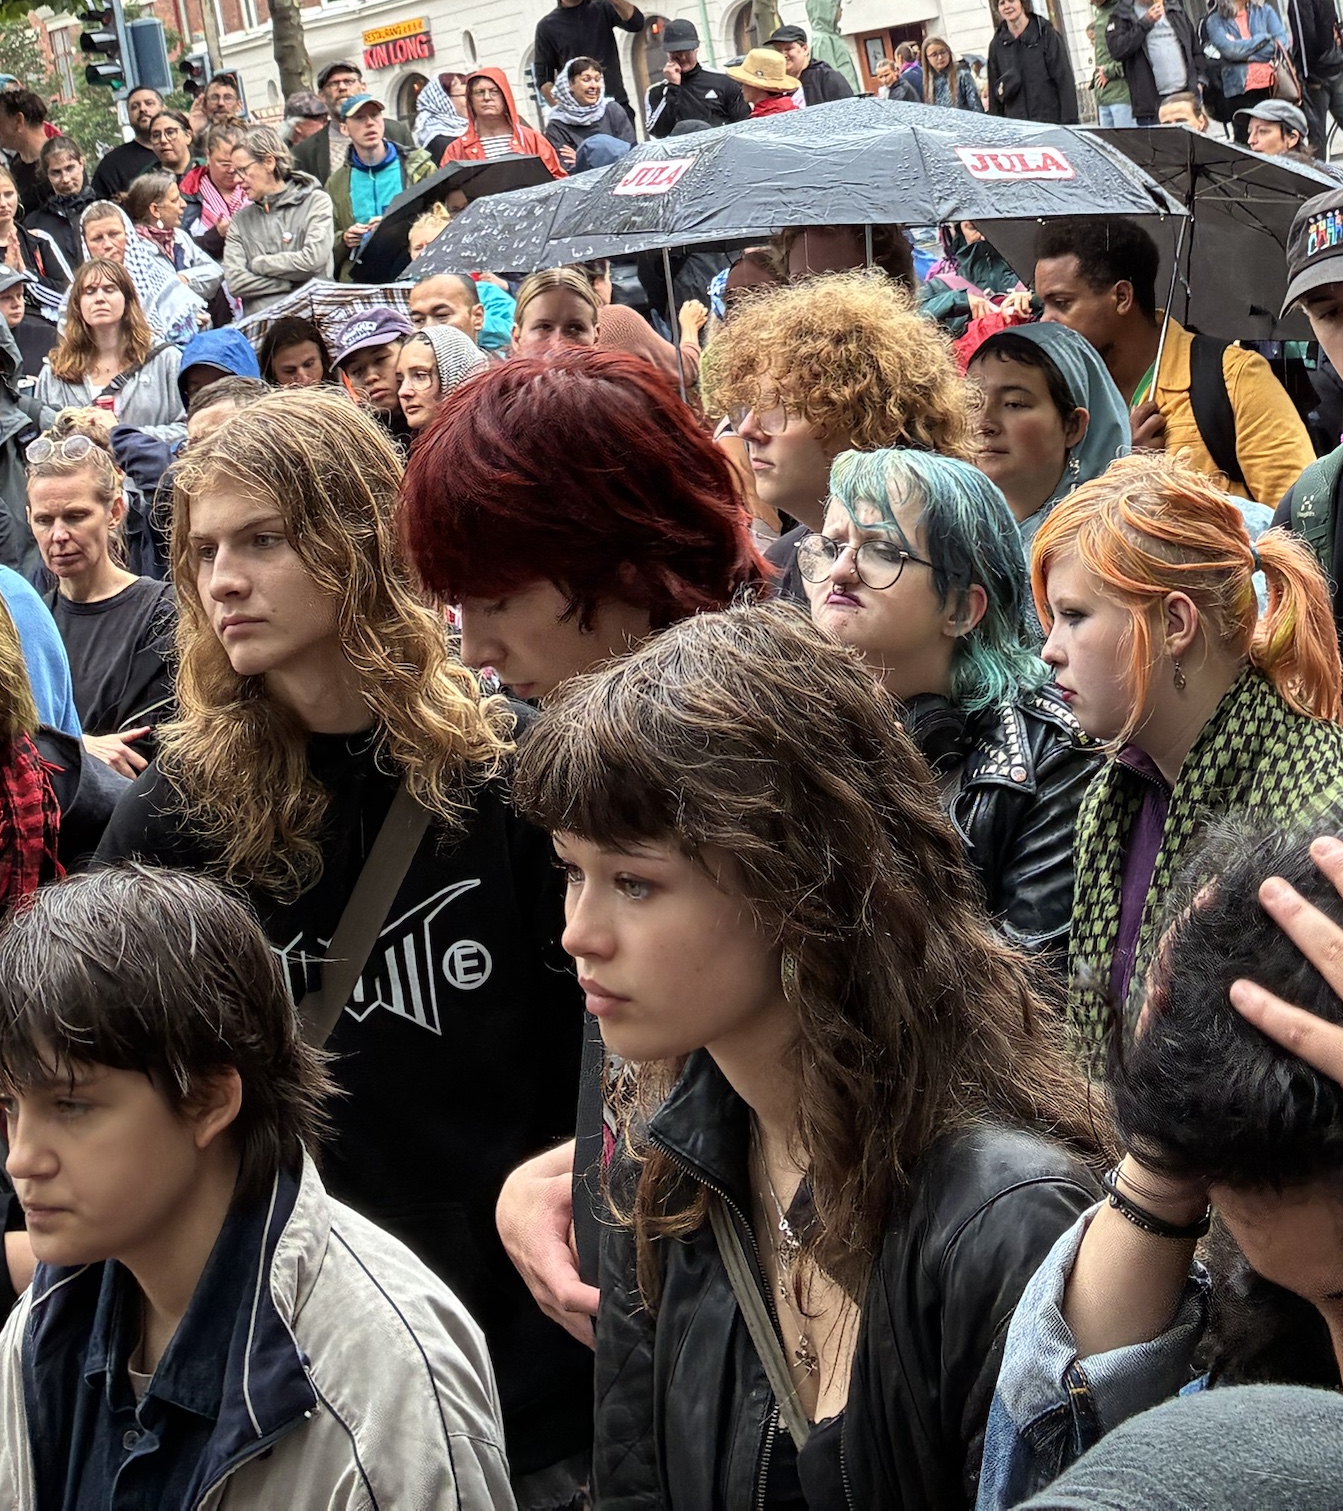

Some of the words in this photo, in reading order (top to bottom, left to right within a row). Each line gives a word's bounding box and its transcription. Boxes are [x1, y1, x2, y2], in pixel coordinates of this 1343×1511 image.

[363, 45, 389, 69] KIN
[389, 34, 429, 65] LONG
[971, 153, 1068, 172] JULA
[622, 165, 682, 187] JULA
